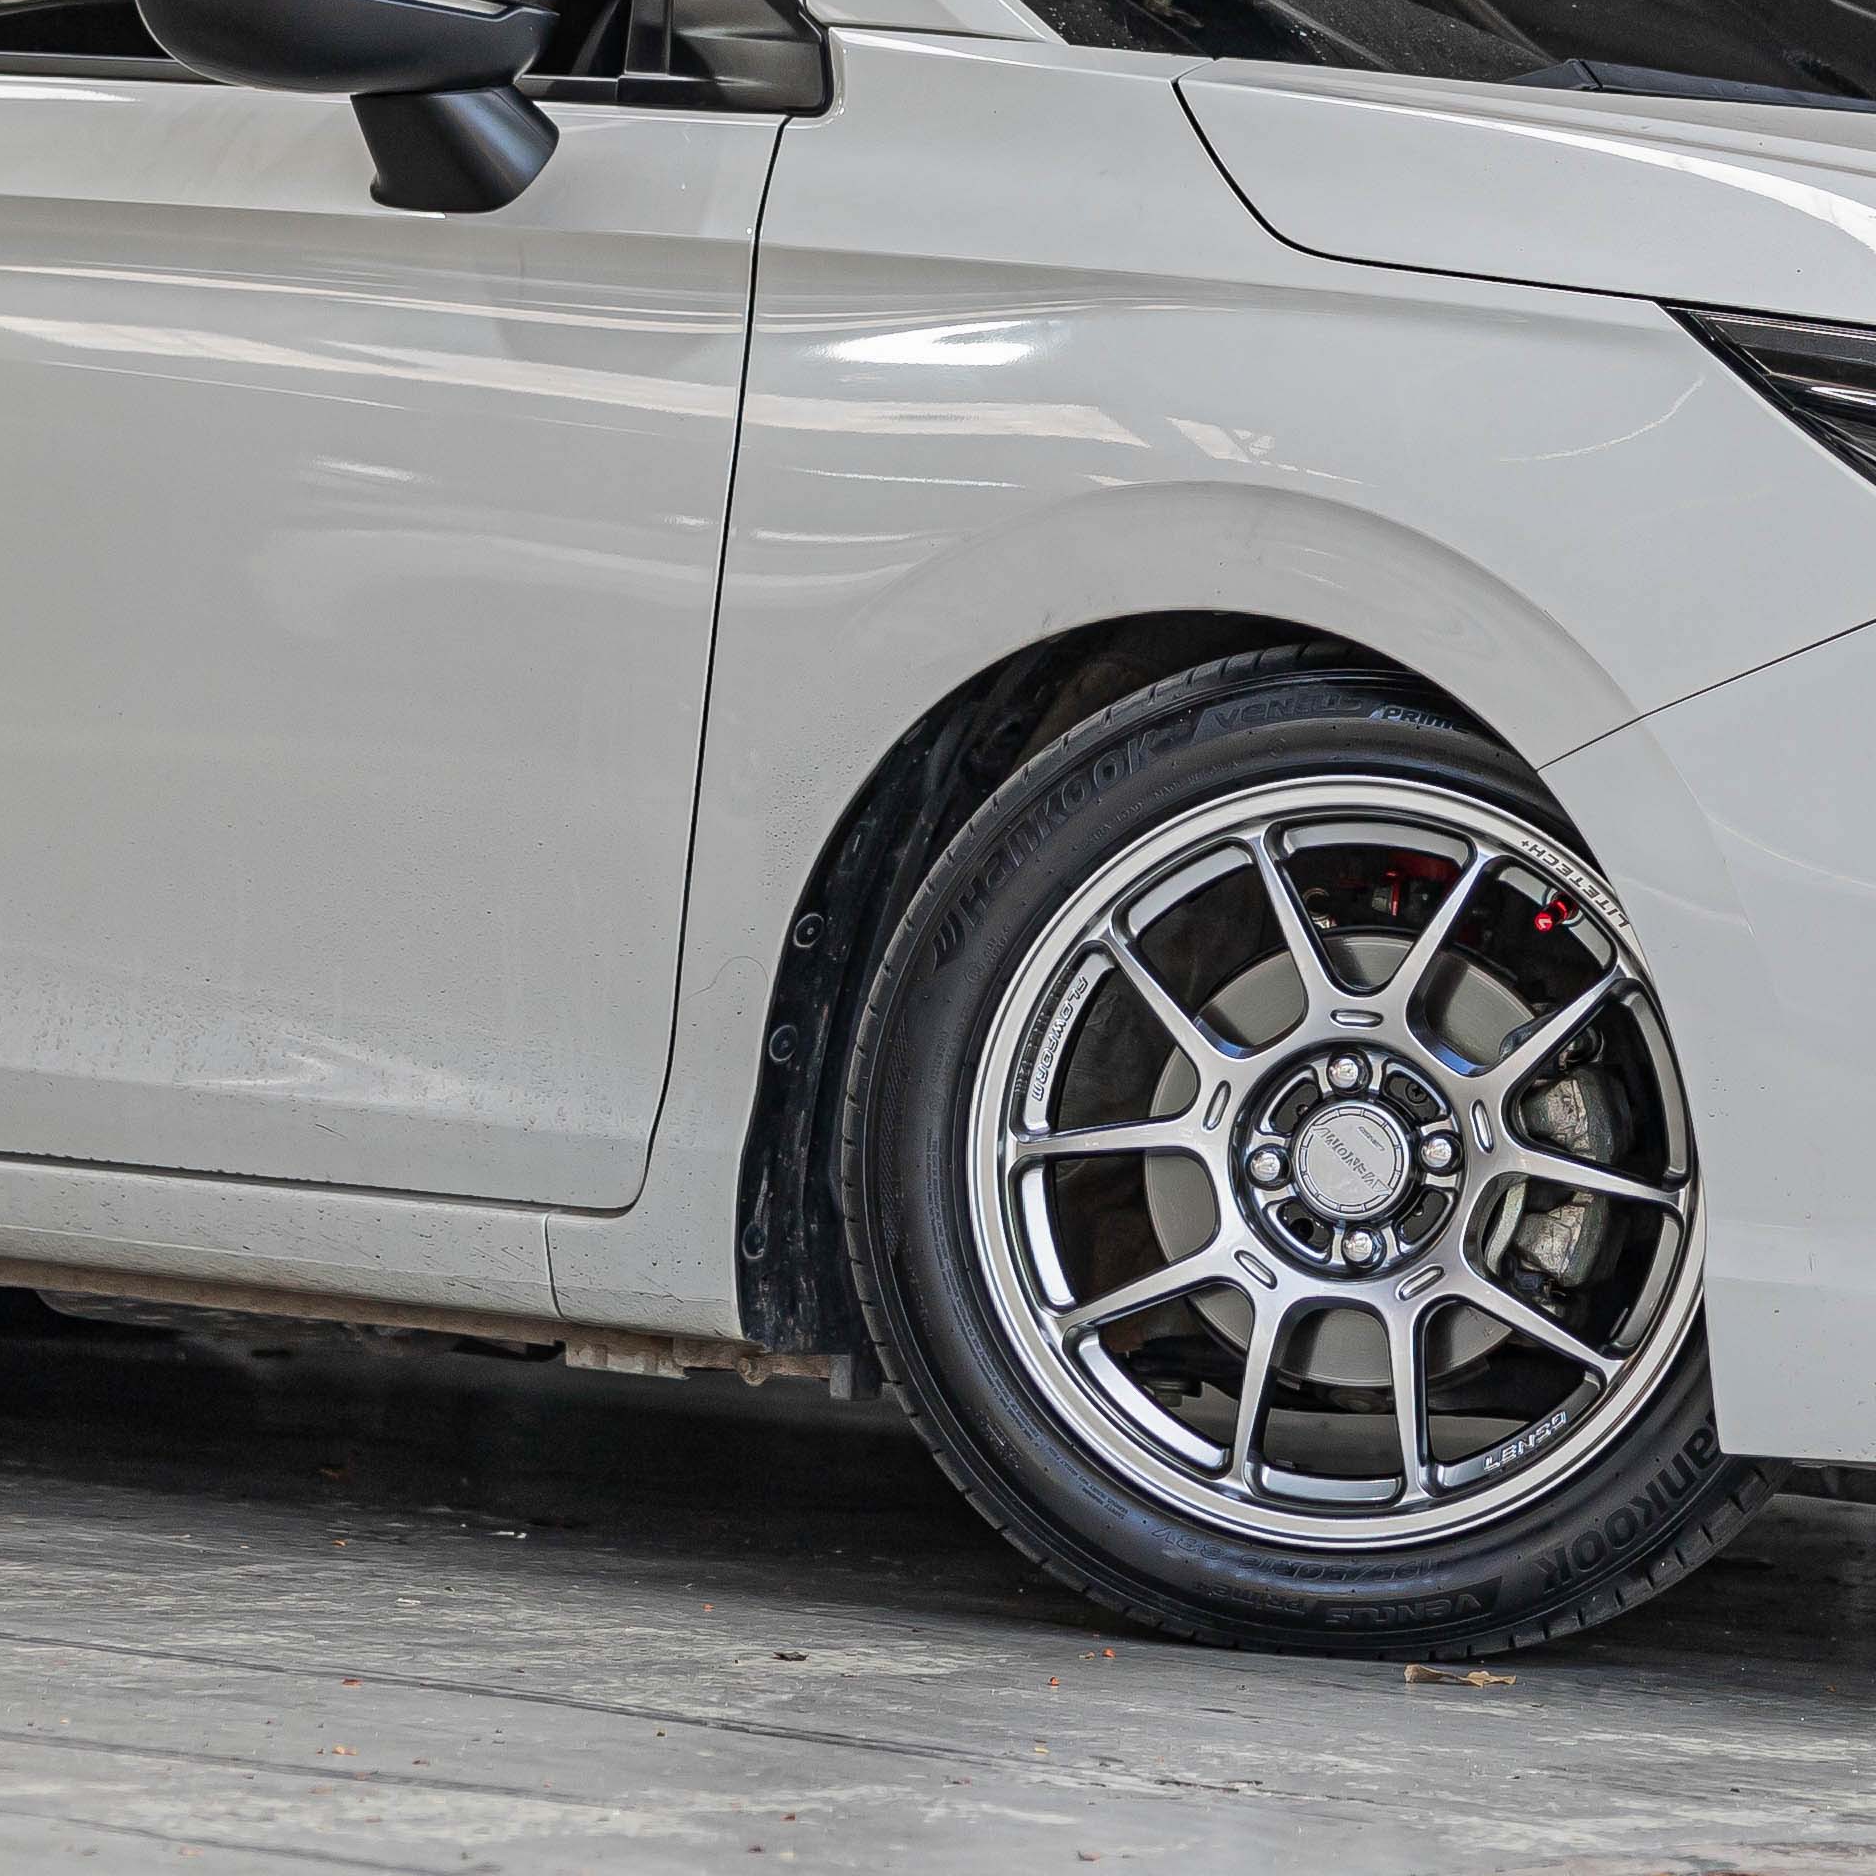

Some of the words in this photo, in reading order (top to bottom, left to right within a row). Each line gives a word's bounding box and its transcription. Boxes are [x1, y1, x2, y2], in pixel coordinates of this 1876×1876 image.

[1520, 839, 1631, 928] LITETECH+
[1032, 974, 1090, 1102] FLOWFORM
[1482, 1410, 1569, 1472] LENSO
